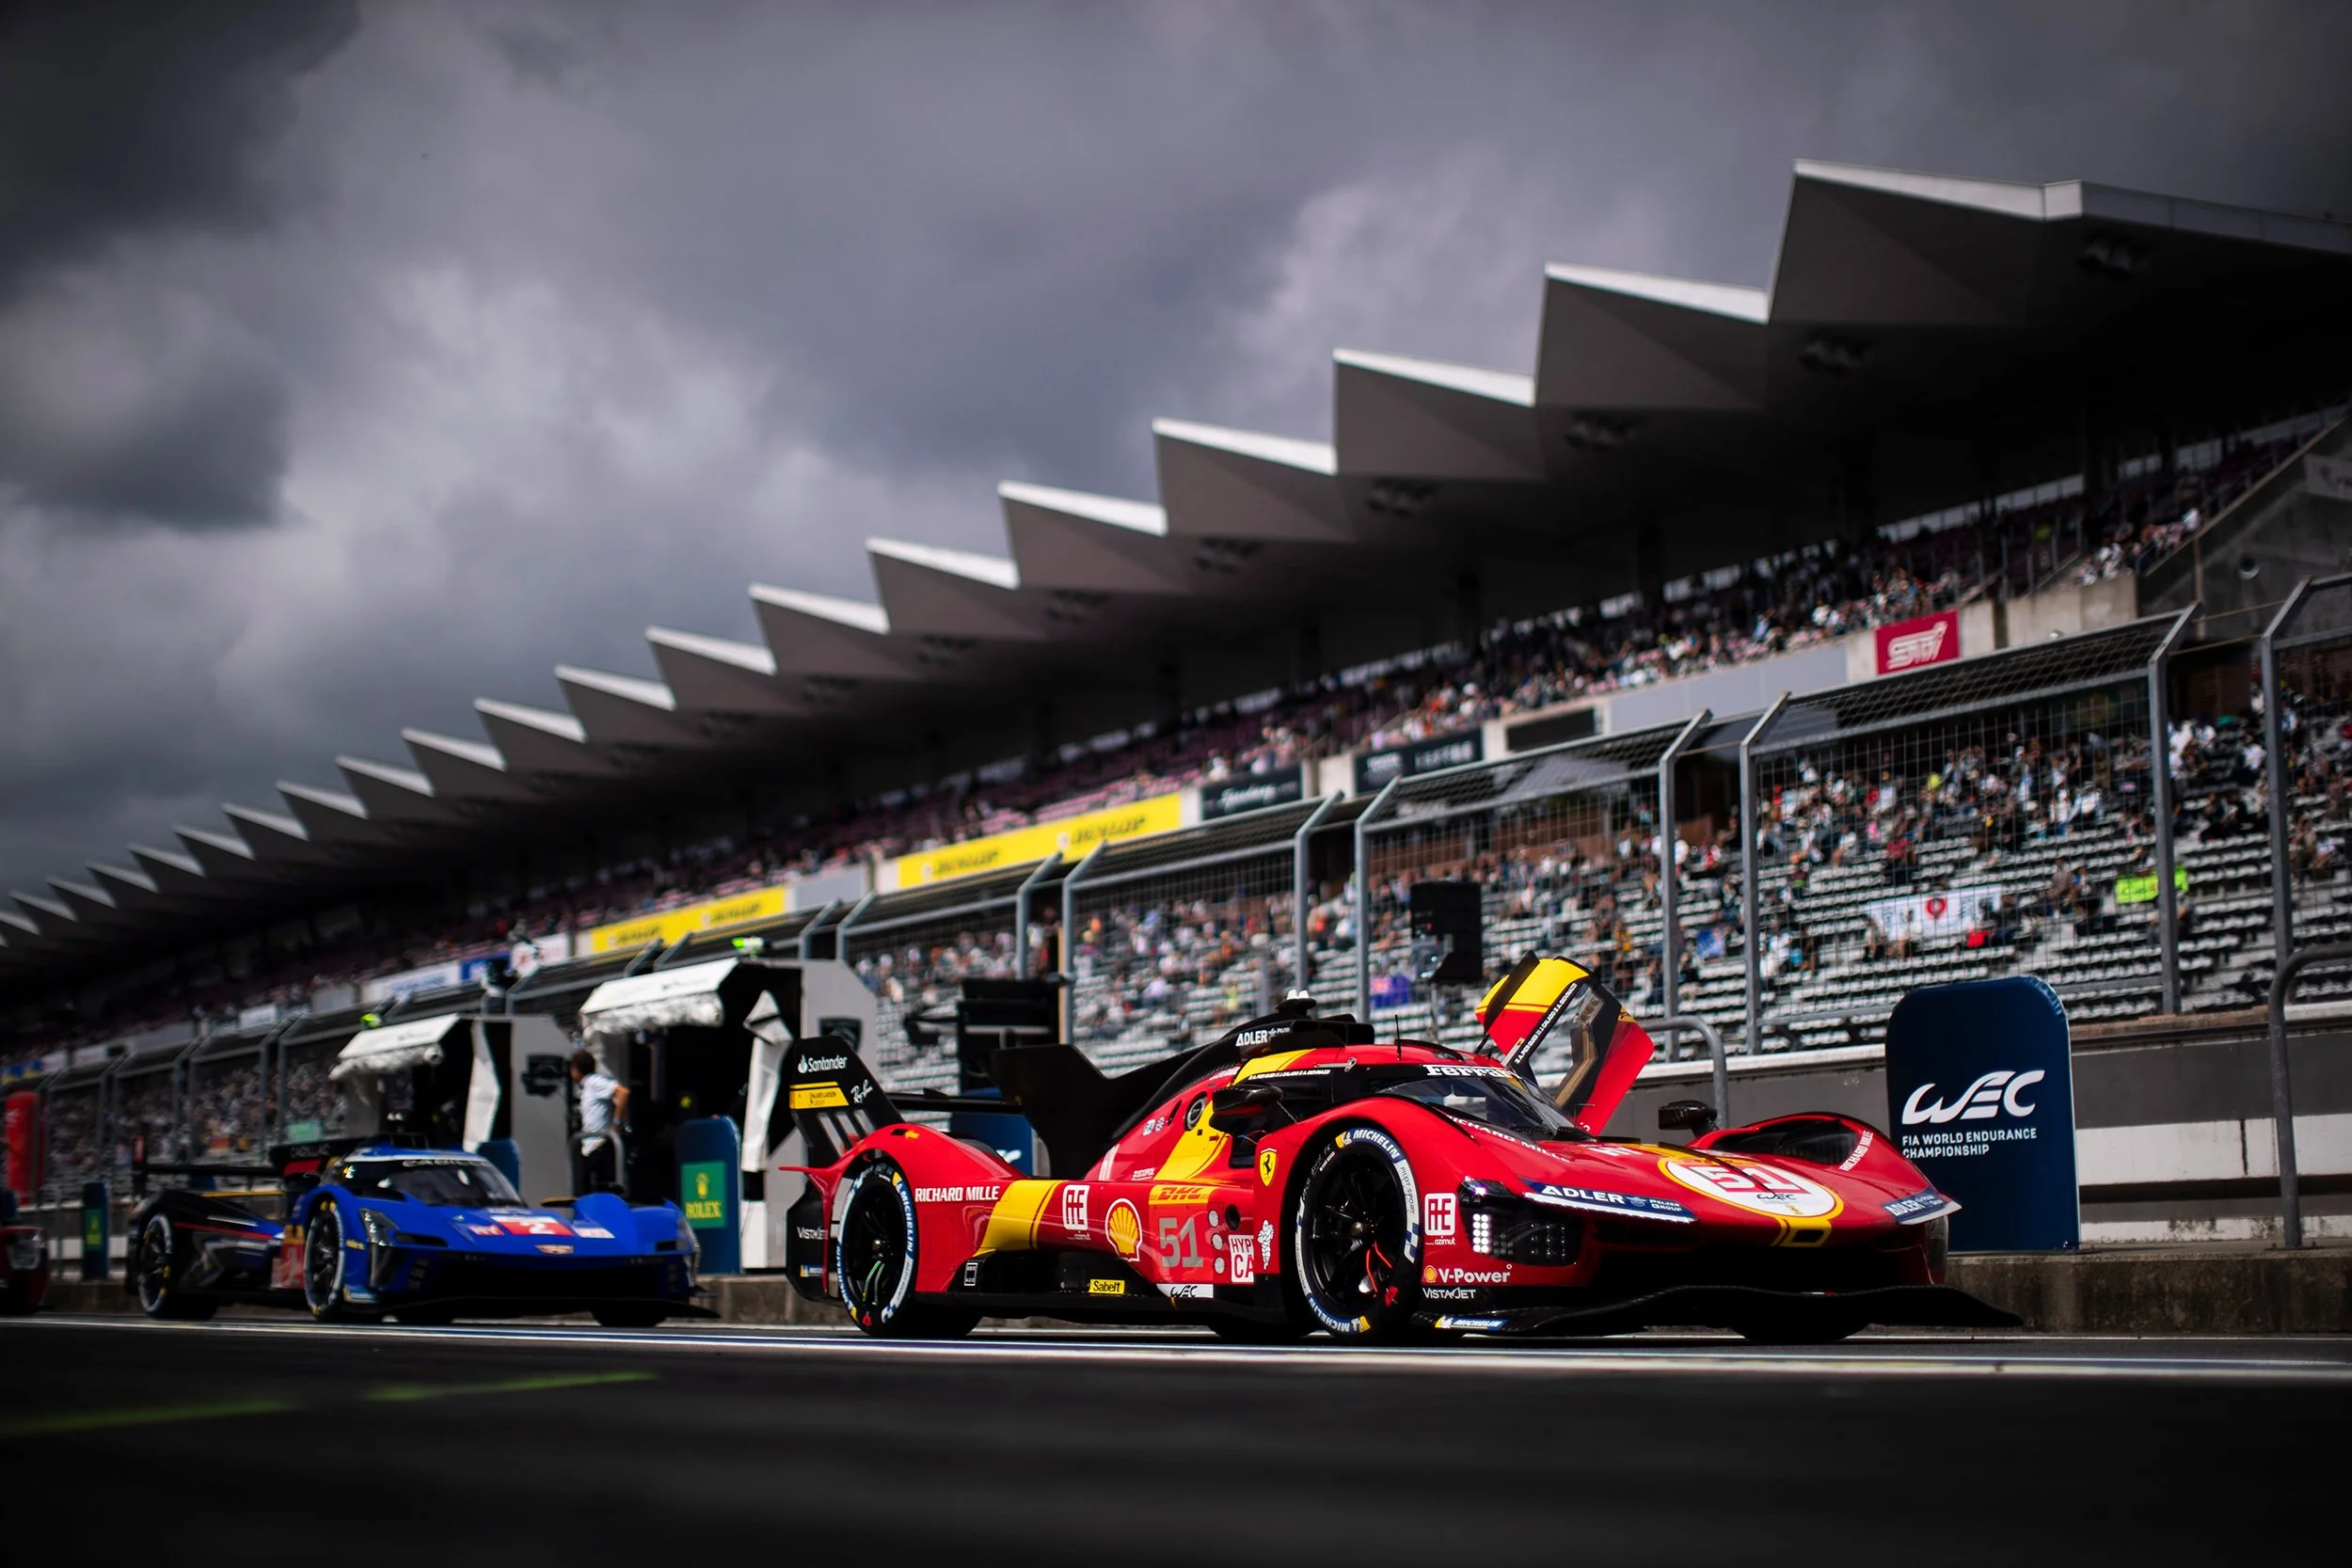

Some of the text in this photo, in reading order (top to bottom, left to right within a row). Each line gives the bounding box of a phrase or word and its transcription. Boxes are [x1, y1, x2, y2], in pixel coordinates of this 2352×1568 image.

[1235, 1030, 1268, 1047] ADLER
[808, 1054, 848, 1072] Santander
[1901, 1069, 2046, 1125] WEC
[1353, 1129, 1401, 1160] MICHELIN
[1902, 1128, 2038, 1147] FIA WORLD ENDURANCE
[1521, 1141, 1571, 1164] MILLE
[1838, 1145, 1868, 1172] RICHARD
[1902, 1144, 1990, 1159] CHAMPIONSHIP
[1687, 1165, 1804, 1191] 51
[914, 1185, 1001, 1203] RICHARD MILLE
[1157, 1186, 1203, 1201] DHL
[1541, 1185, 1626, 1205] ADLER
[685, 1200, 723, 1219] ROLEX
[1651, 1204, 1682, 1212] GROUP
[1883, 1199, 1926, 1217] ADLER
[898, 1182, 914, 1254] MICHELIN
[1158, 1217, 1203, 1268] 51
[1231, 1238, 1252, 1250] HYP
[1434, 1235, 1456, 1245] azimut
[1233, 1254, 1254, 1278] CA
[1438, 1268, 1511, 1284] V-Power
[1092, 1280, 1121, 1293] Sabelt
[1422, 1286, 1477, 1299] VISTAJET
[1309, 1296, 1350, 1333] MICHELIN
[1453, 1319, 1503, 1327] MICHELIN
